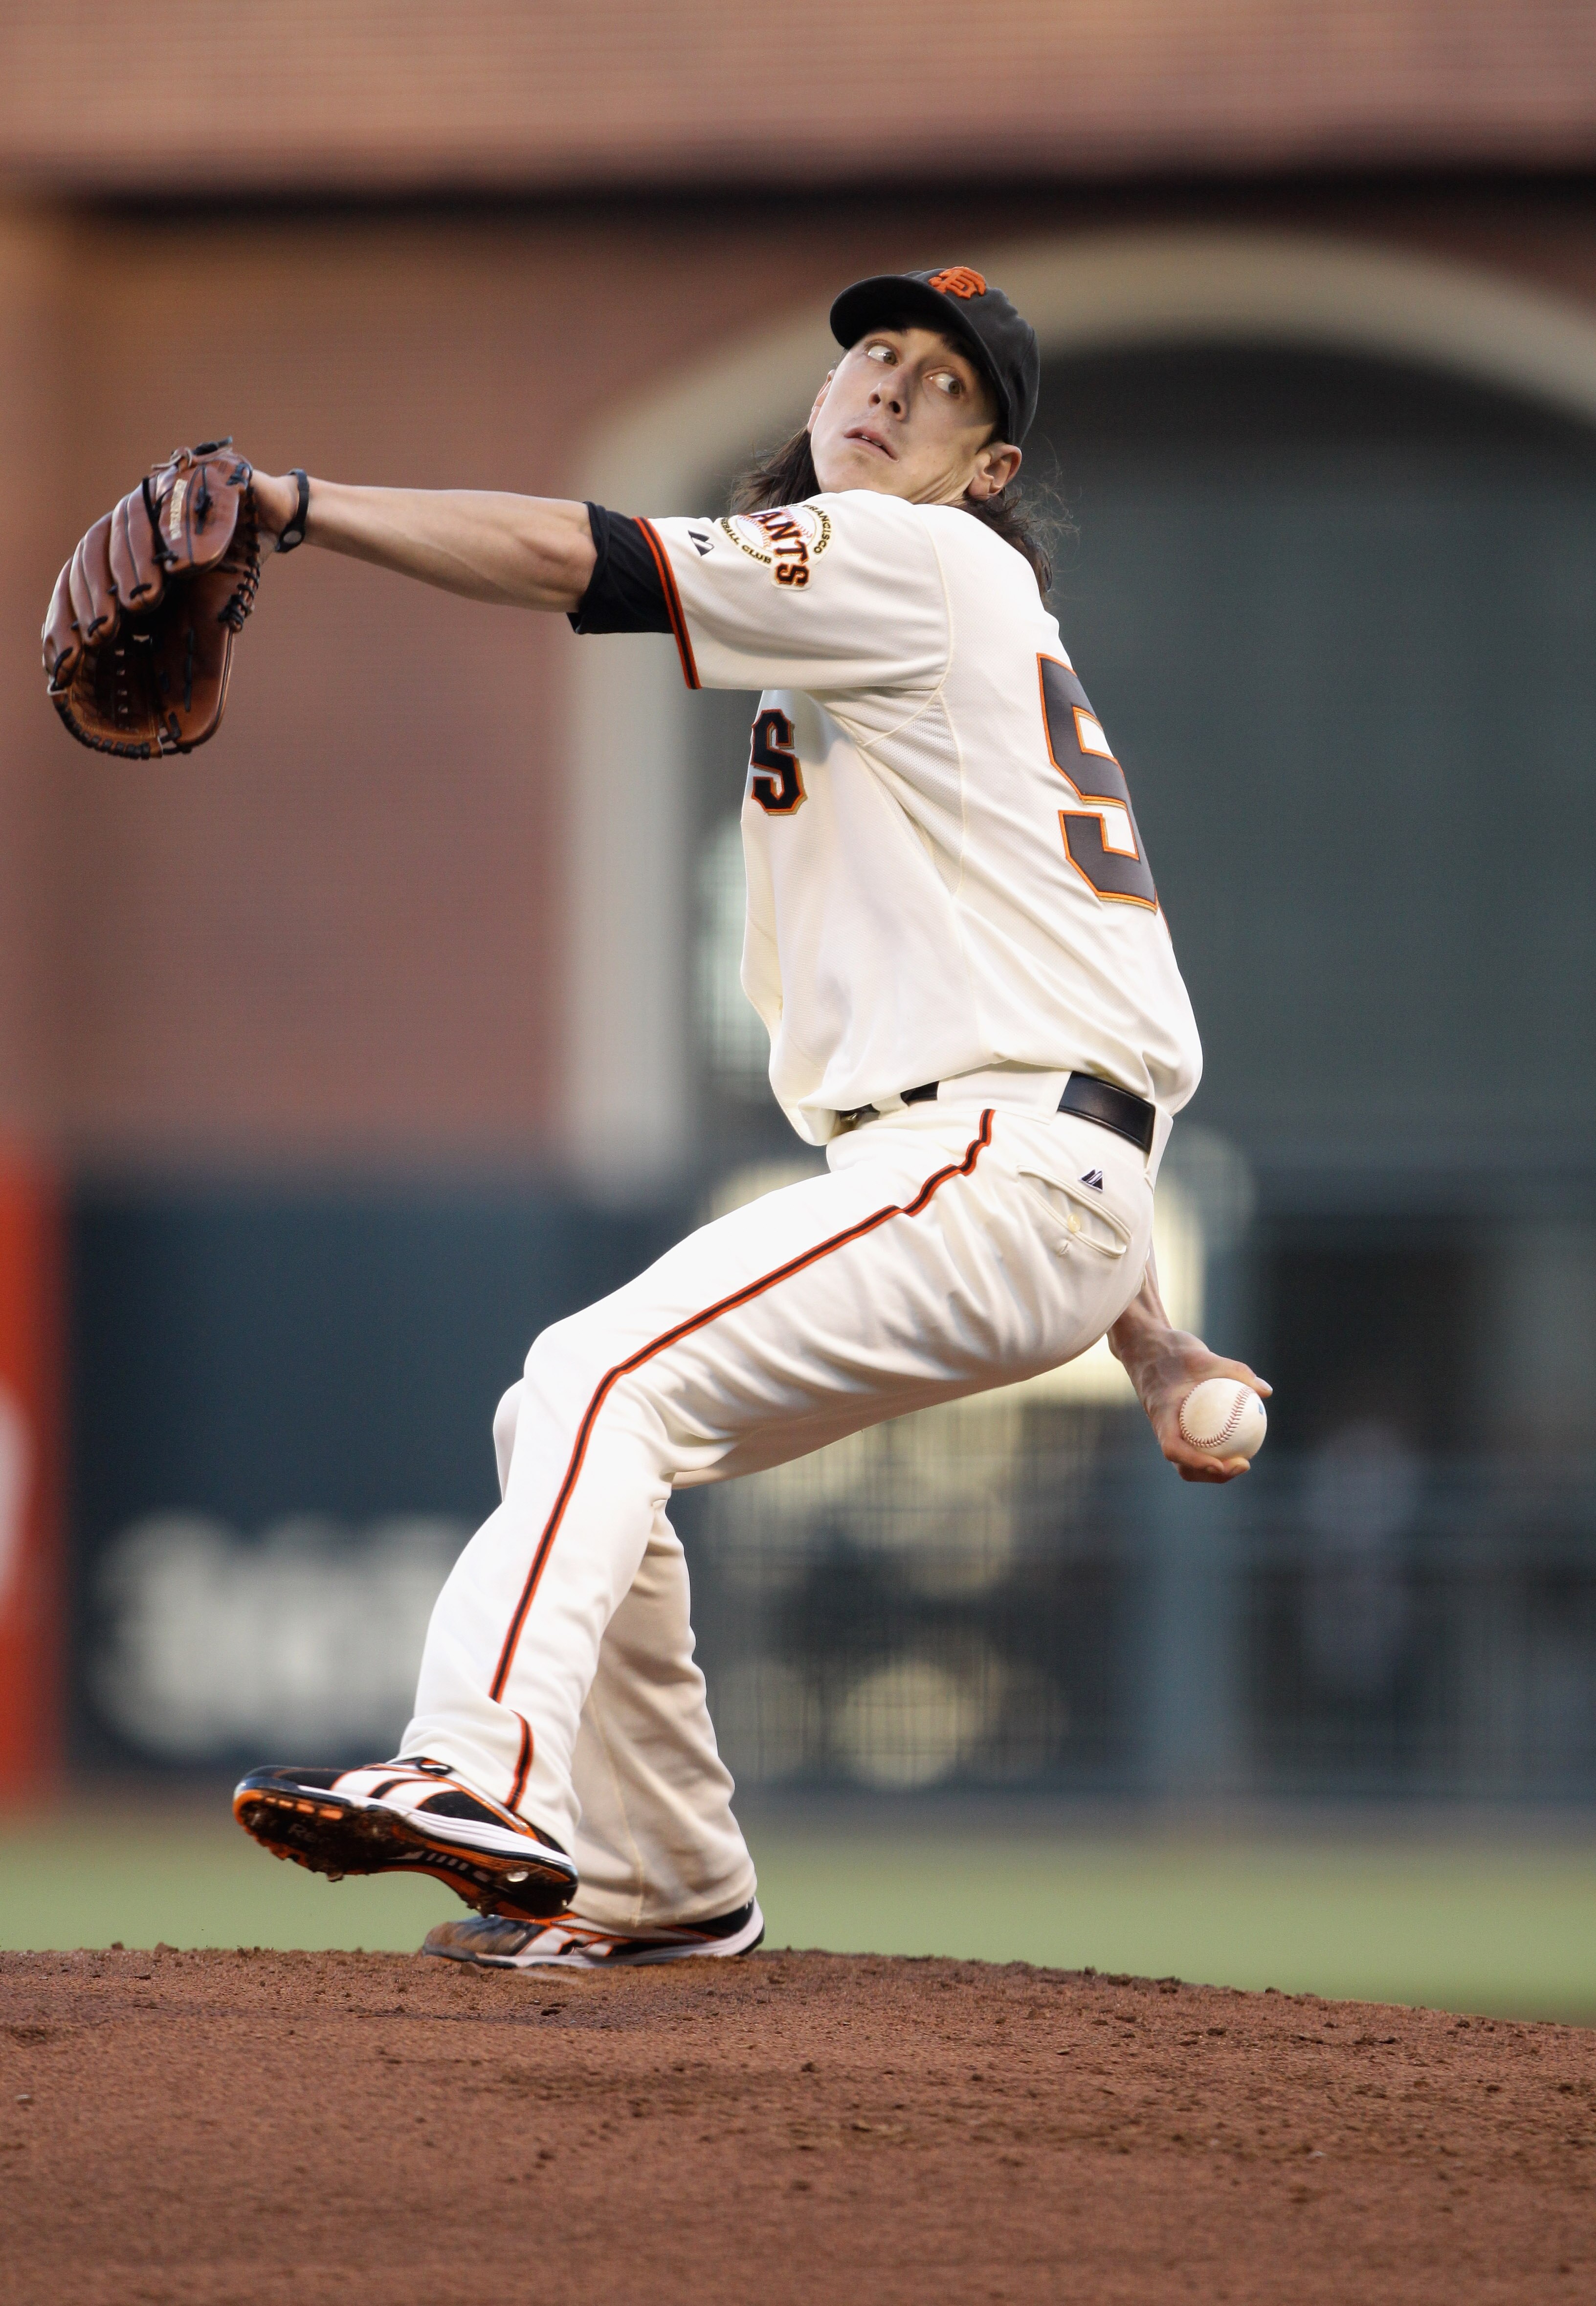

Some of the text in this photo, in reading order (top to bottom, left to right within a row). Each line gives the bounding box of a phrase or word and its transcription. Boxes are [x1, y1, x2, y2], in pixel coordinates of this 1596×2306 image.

[741, 545, 772, 564] CLUB
[746, 511, 810, 586] ANTS
[801, 504, 831, 554] FRANCISCO
[751, 709, 808, 816] S
